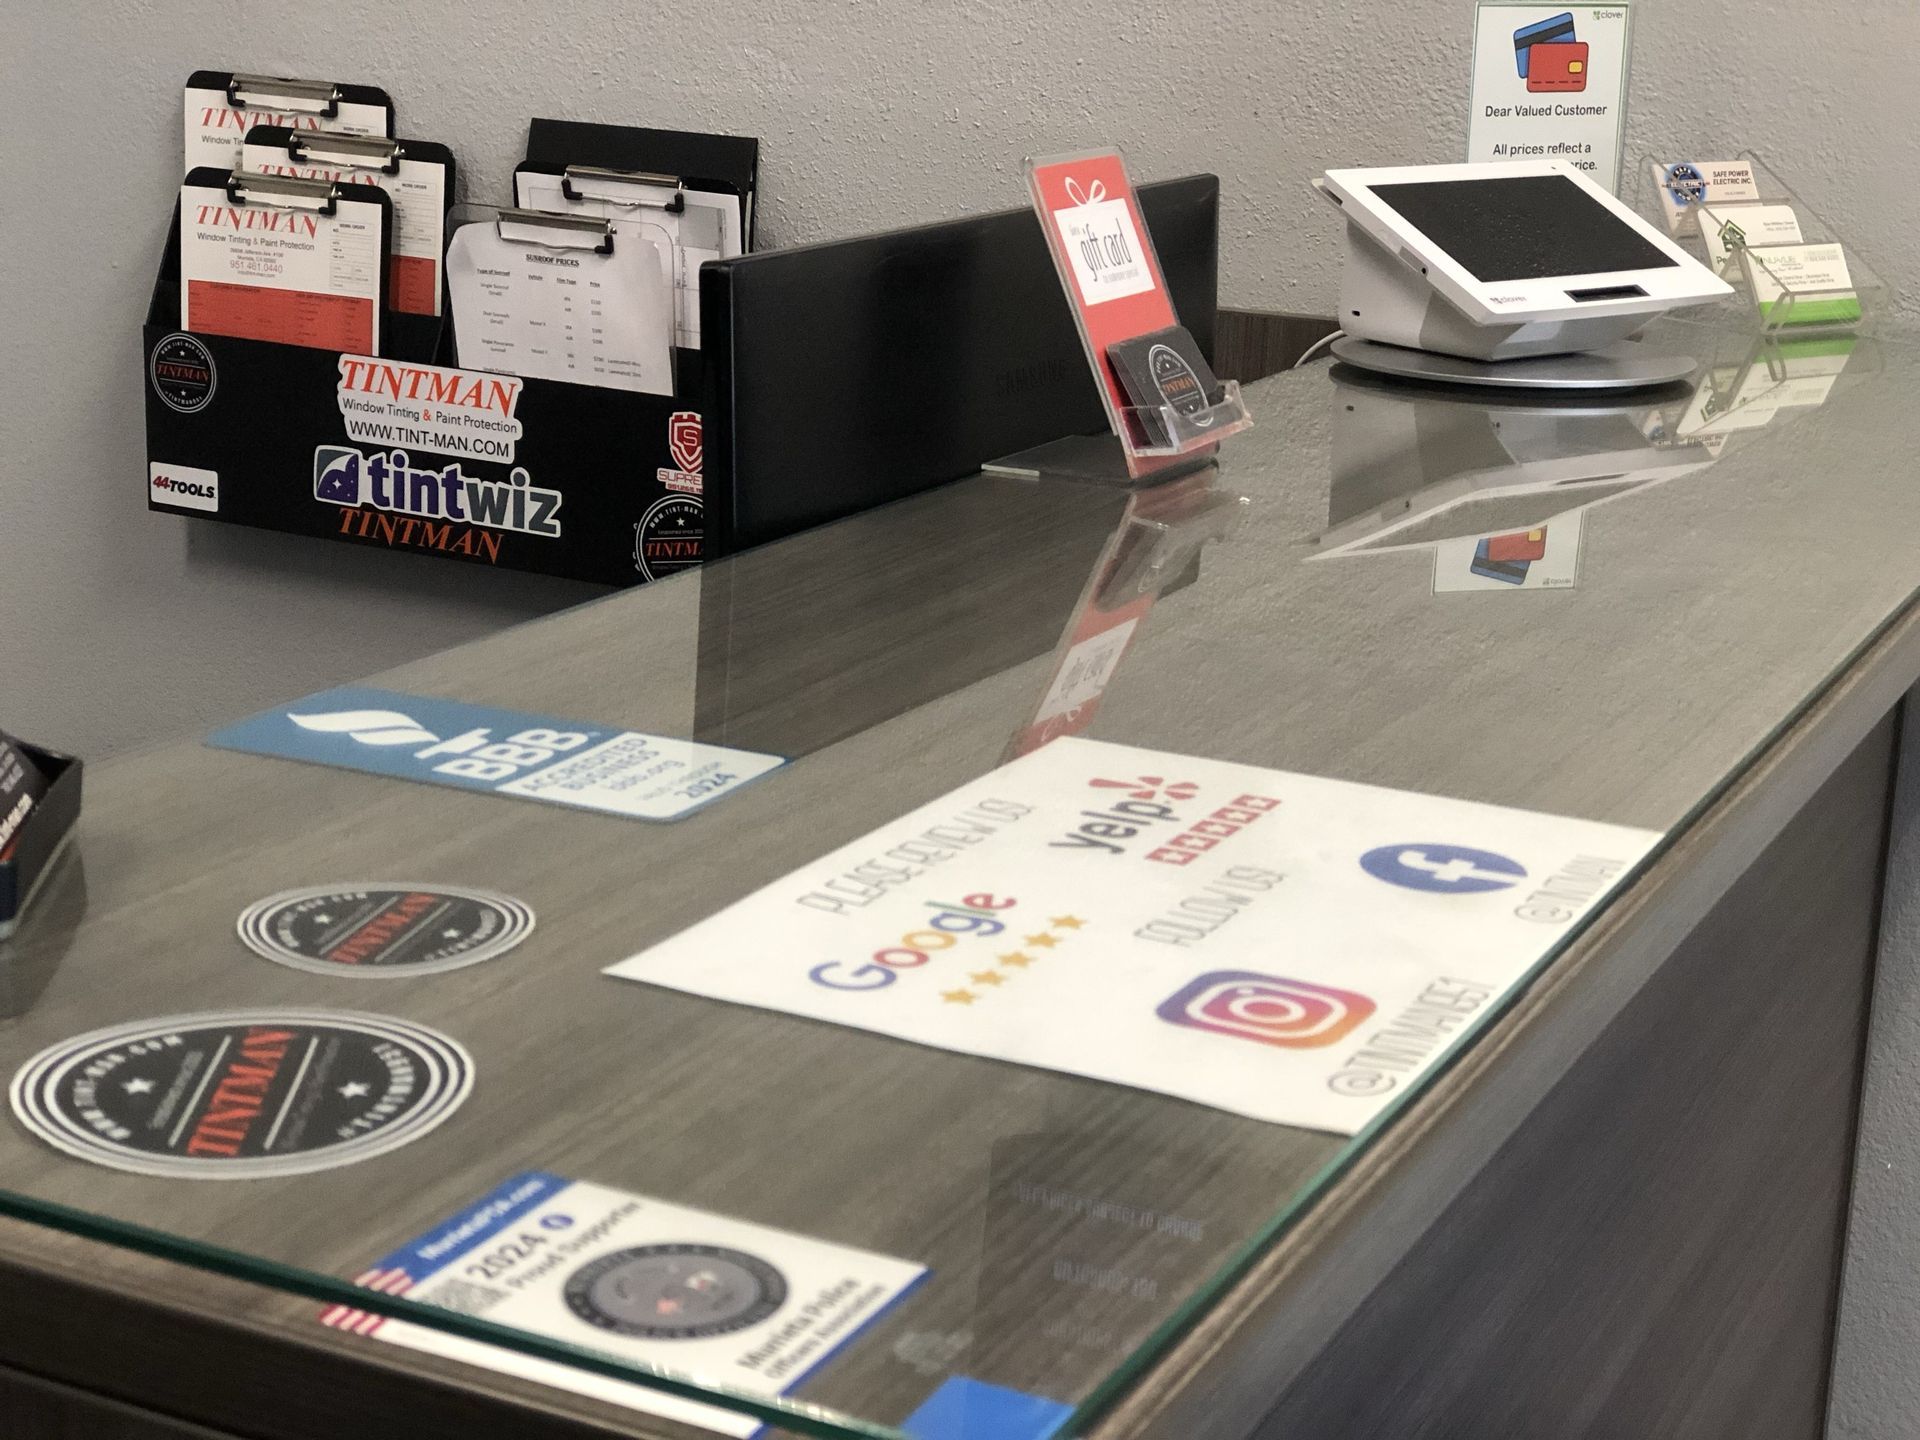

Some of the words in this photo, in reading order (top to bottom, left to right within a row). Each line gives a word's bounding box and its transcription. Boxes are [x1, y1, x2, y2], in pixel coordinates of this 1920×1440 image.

[1600, 10, 1624, 19] clover
[1485, 106, 1512, 118] Dear
[1514, 105, 1552, 117] Valued
[1554, 104, 1607, 116] Customer
[201, 135, 231, 145] Window
[1493, 144, 1507, 155] All
[1509, 144, 1544, 157] prices
[1547, 143, 1582, 154] reflect
[197, 205, 319, 239] TINTMAN
[197, 232, 226, 242] Window
[228, 235, 252, 247] Tinting
[260, 238, 278, 247] Paint
[280, 240, 315, 251] Protection
[526, 254, 554, 264] SUNROOF
[555, 258, 580, 267] PRICES
[1080, 223, 1108, 282] gift
[1103, 217, 1133, 267] card
[156, 363, 209, 382] TINTMAN
[342, 359, 518, 417] TINTMAN
[342, 397, 385, 414] Window
[386, 403, 420, 422] Tinting
[423, 409, 432, 421] &
[436, 411, 462, 426] Paint
[463, 416, 518, 434] Protection
[350, 420, 510, 458] WWW.TINT-MAN.COM
[152, 475, 215, 498] 44TOOLS
[367, 453, 559, 532] tintwiz
[658, 470, 702, 486] SUPRE
[338, 507, 505, 565] TINTMAN
[645, 541, 702, 559] TINTM
[432, 728, 590, 781] BBB
[521, 738, 648, 792] ACCREDITED
[559, 750, 660, 791] BUSINESS
[673, 770, 737, 800] 2024
[1048, 799, 1182, 855] yelp
[796, 858, 926, 916] PLEASE
[885, 811, 998, 866] REVIEW
[328, 893, 435, 964] TINTMAN
[1134, 881, 1254, 948] FOLLOW
[808, 891, 1018, 991] Google
[187, 1024, 298, 1157] TINTMAN
[466, 1231, 548, 1279] 2024
